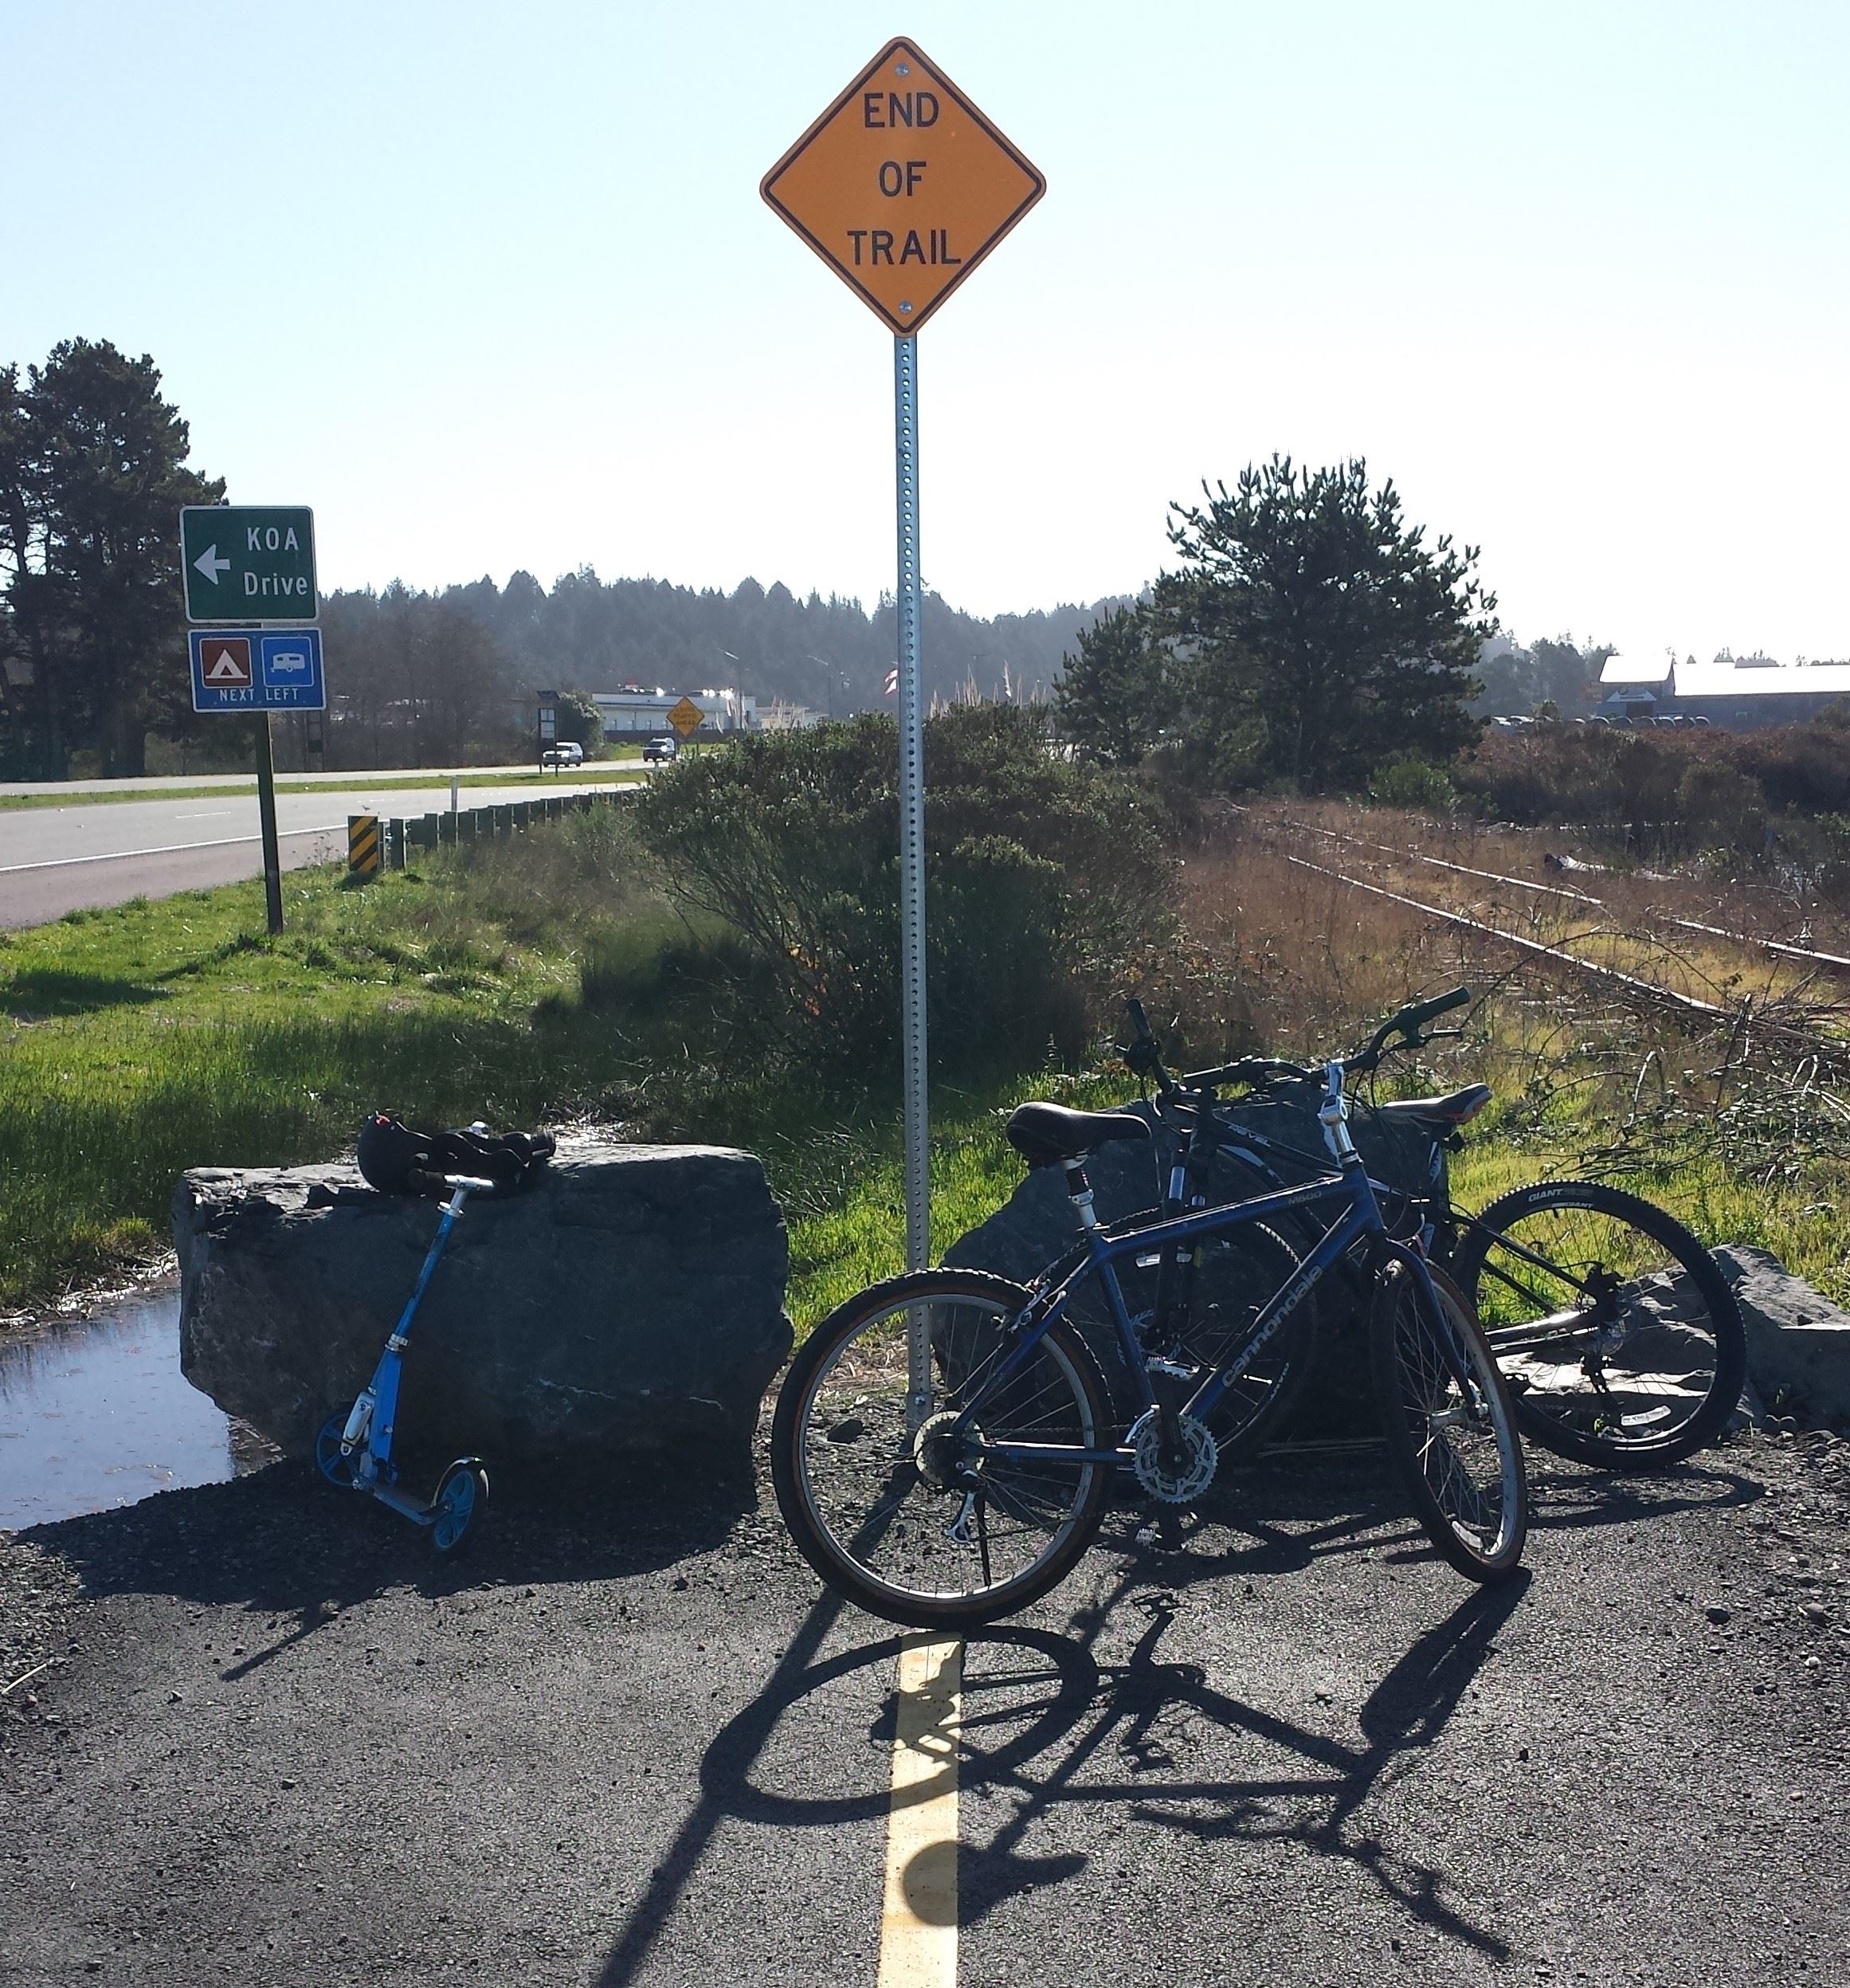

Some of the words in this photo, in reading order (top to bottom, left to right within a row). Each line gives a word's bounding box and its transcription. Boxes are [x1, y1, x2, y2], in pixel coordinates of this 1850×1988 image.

[864, 92, 939, 127] END
[879, 161, 927, 197] OF
[847, 229, 962, 265] TRAIL
[247, 527, 299, 551] KOA
[244, 572, 308, 595] Drive
[219, 688, 255, 701] NEXT
[266, 688, 299, 700] LEFT
[1527, 1188, 1563, 1202] GIANT
[1221, 1265, 1323, 1387] cannondale
